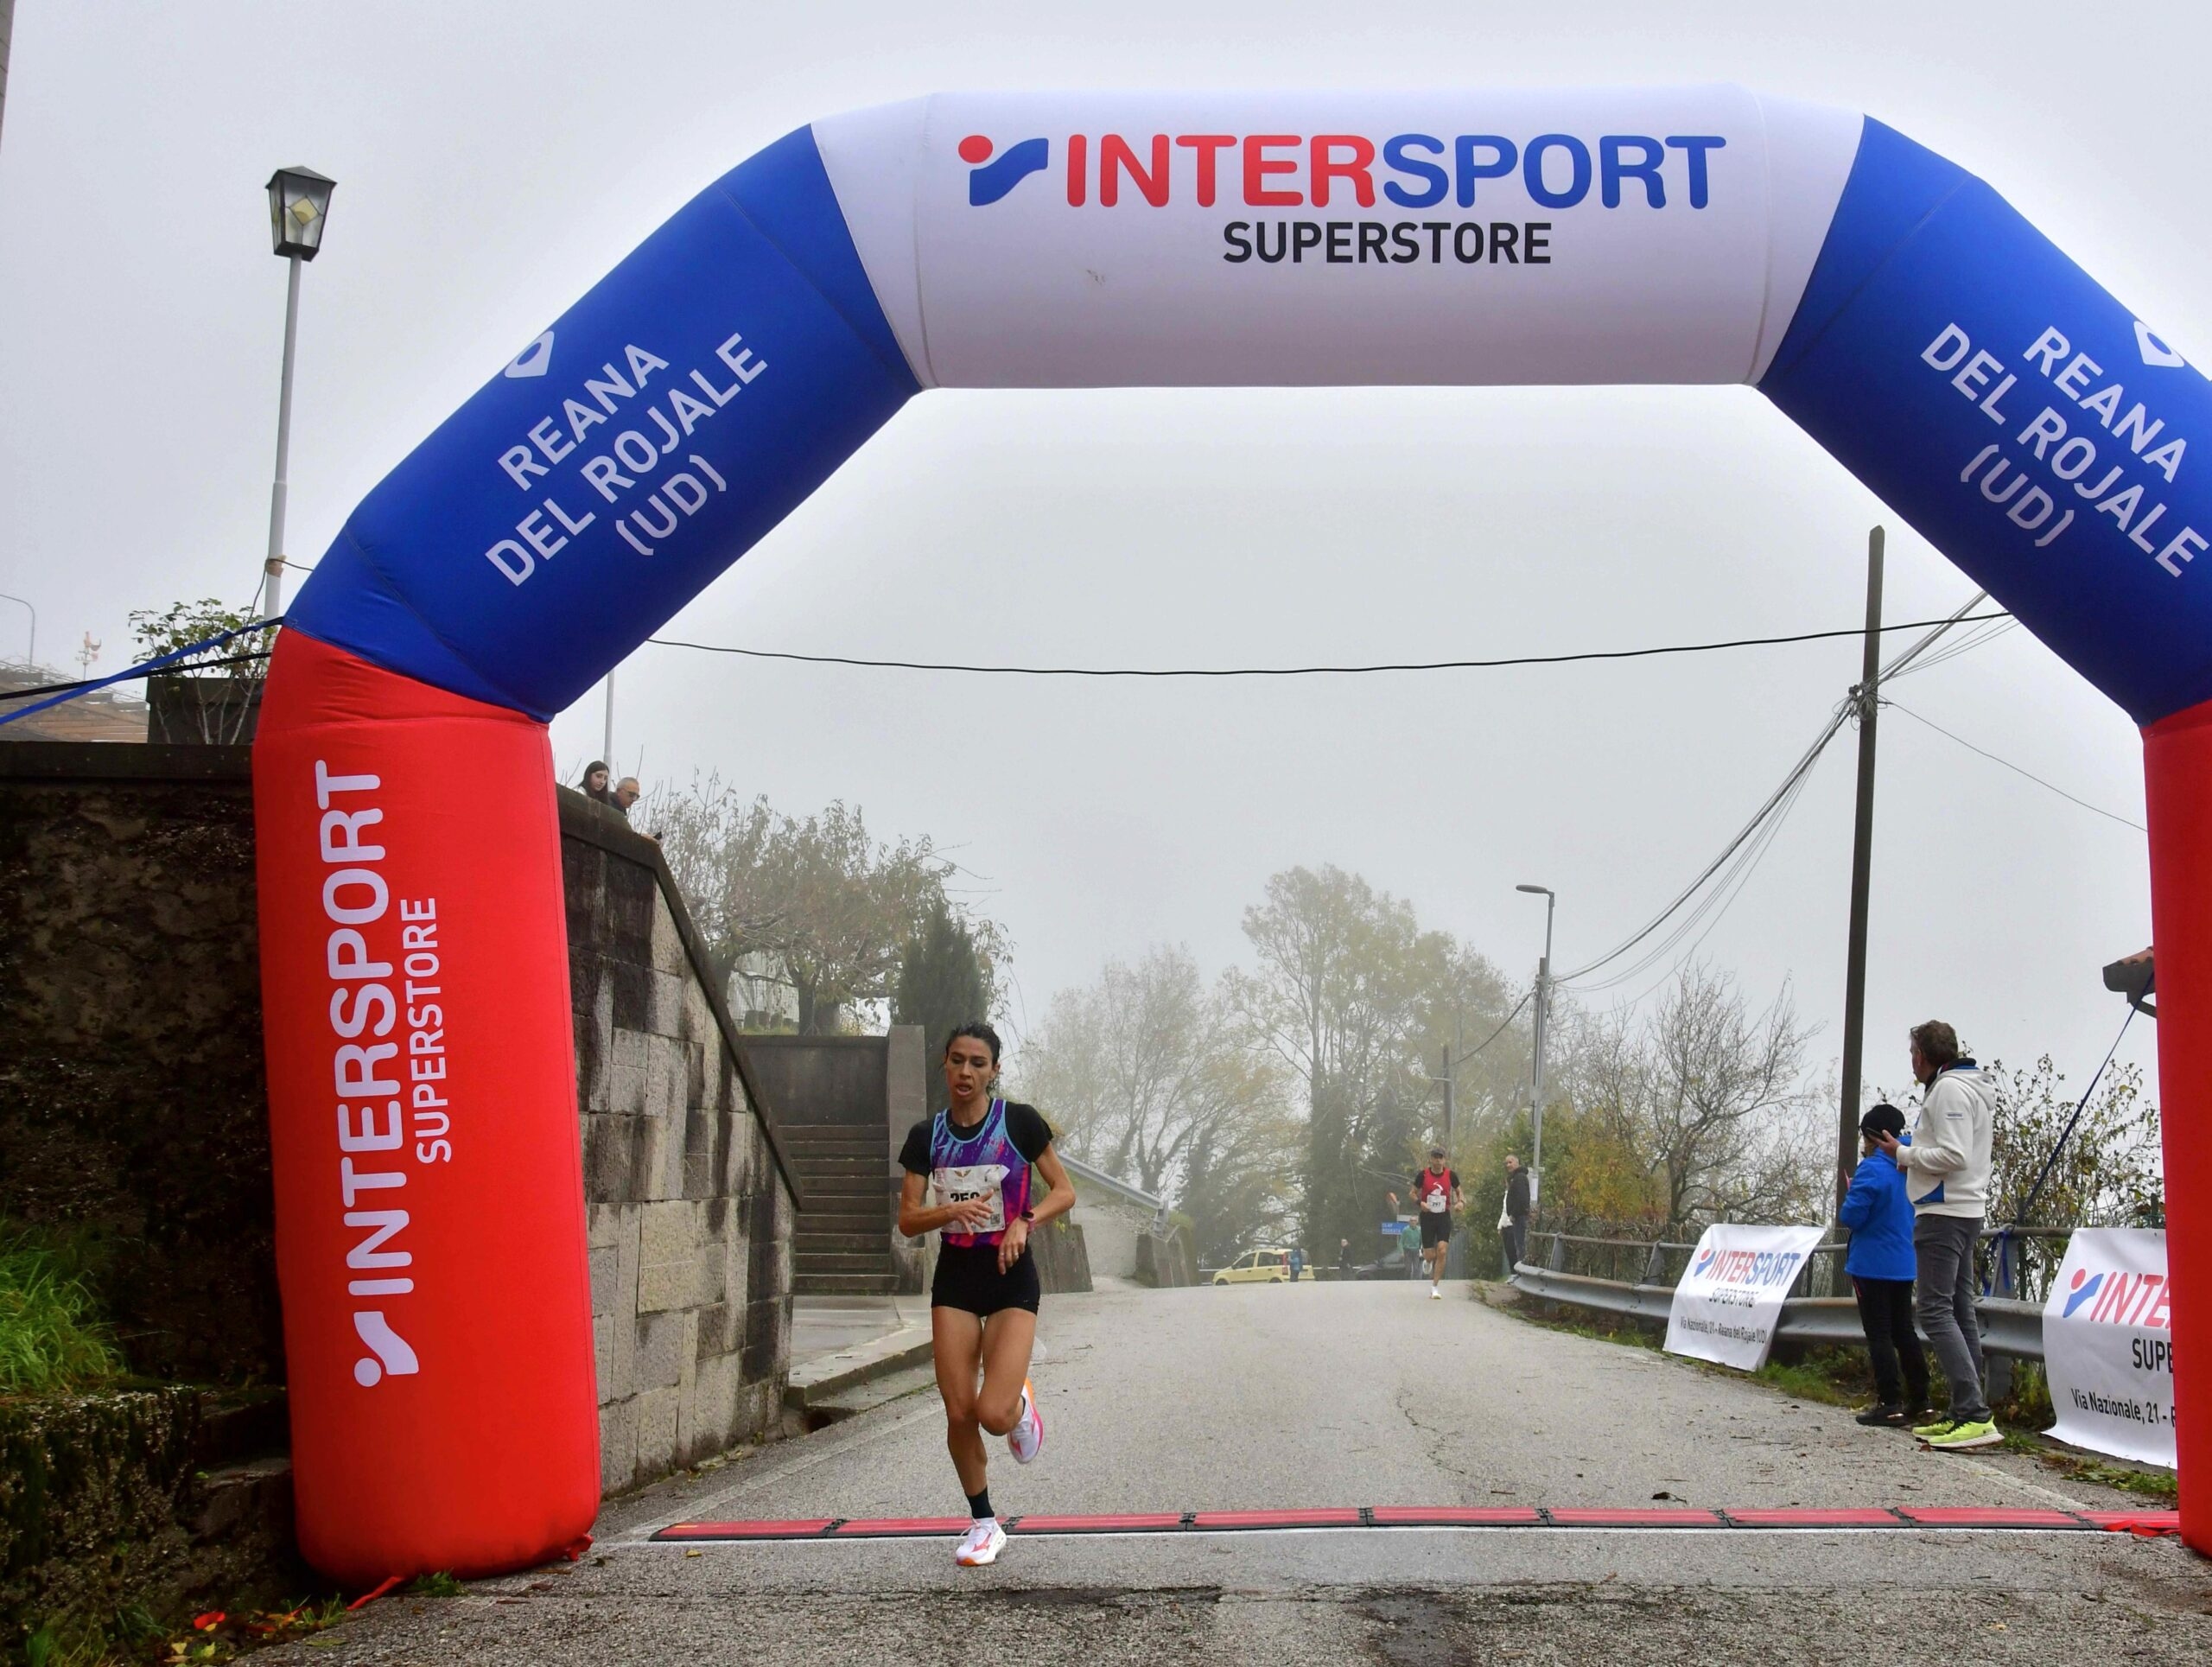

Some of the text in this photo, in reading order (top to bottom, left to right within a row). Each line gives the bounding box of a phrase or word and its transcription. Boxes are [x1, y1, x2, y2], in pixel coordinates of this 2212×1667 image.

[1067, 134, 1726, 209] INTERSPORT
[1223, 220, 1552, 264] SUPERSTORE
[498, 343, 671, 492] REANA
[1920, 322, 2210, 578] DEL ROJALE
[2023, 326, 2188, 483] REANA
[485, 332, 768, 587] DEL ROJALE
[615, 454, 727, 556] (UD)
[1960, 444, 2075, 547] (UD)
[315, 759, 414, 1296] INTERSPORT
[399, 896, 452, 1164] SUPERSTORE
[1706, 1250, 1801, 1287] INTERSPORT
[2090, 1271, 2171, 1329] INTE
[1718, 1322, 1732, 1338] Reana
[2070, 1388, 2088, 1410] Via
[2088, 1391, 2145, 1425] Nazionale,
[2145, 1401, 2159, 1425] 21
